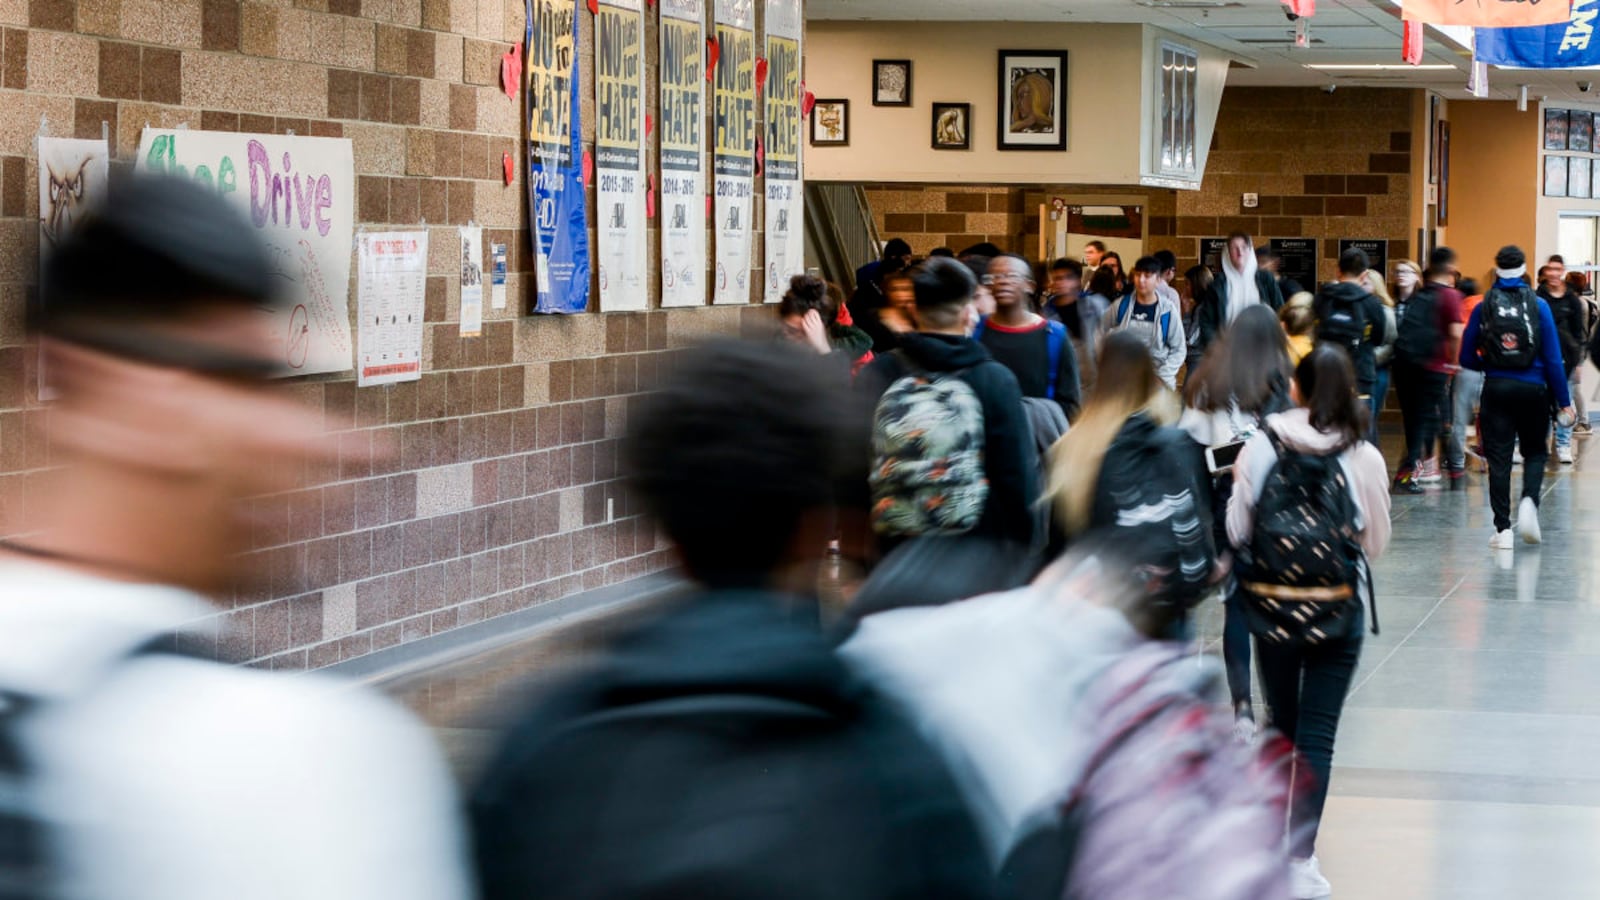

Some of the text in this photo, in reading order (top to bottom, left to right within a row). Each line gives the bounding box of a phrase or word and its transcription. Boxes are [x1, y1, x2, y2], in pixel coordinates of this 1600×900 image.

[600, 12, 620, 78] NO
[624, 53, 637, 79] for
[663, 23, 682, 85] NO
[717, 31, 736, 93] NO
[769, 43, 784, 100] NO
[685, 62, 699, 86] for
[738, 70, 752, 93] for
[600, 81, 637, 142] HATE
[663, 88, 699, 145] HATE
[716, 95, 752, 151] HATE
[247, 139, 331, 236] Drive
